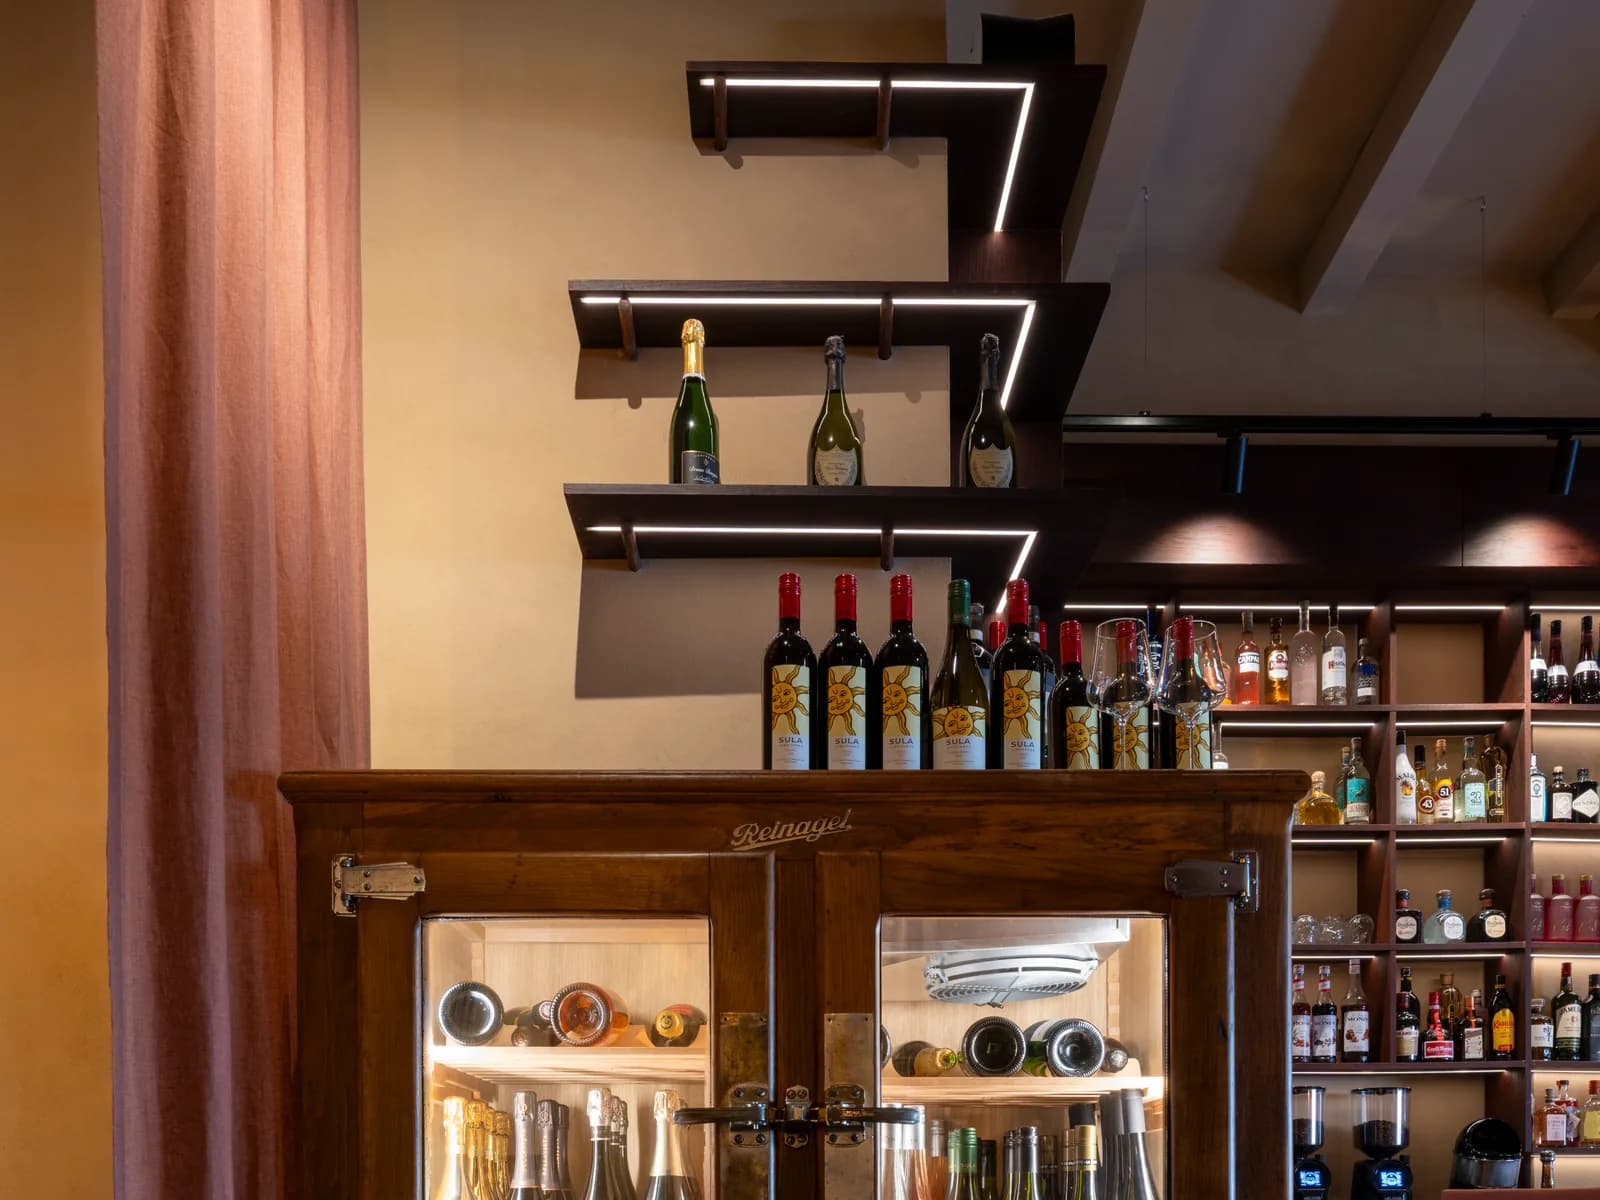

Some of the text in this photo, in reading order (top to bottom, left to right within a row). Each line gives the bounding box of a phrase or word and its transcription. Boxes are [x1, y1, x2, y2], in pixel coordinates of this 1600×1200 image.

[778, 736, 803, 744] SULA
[1010, 740, 1035, 748] SULA
[1440, 788, 1450, 796] 51
[1421, 801, 1433, 809] 43
[731, 808, 853, 849] Reinagel
